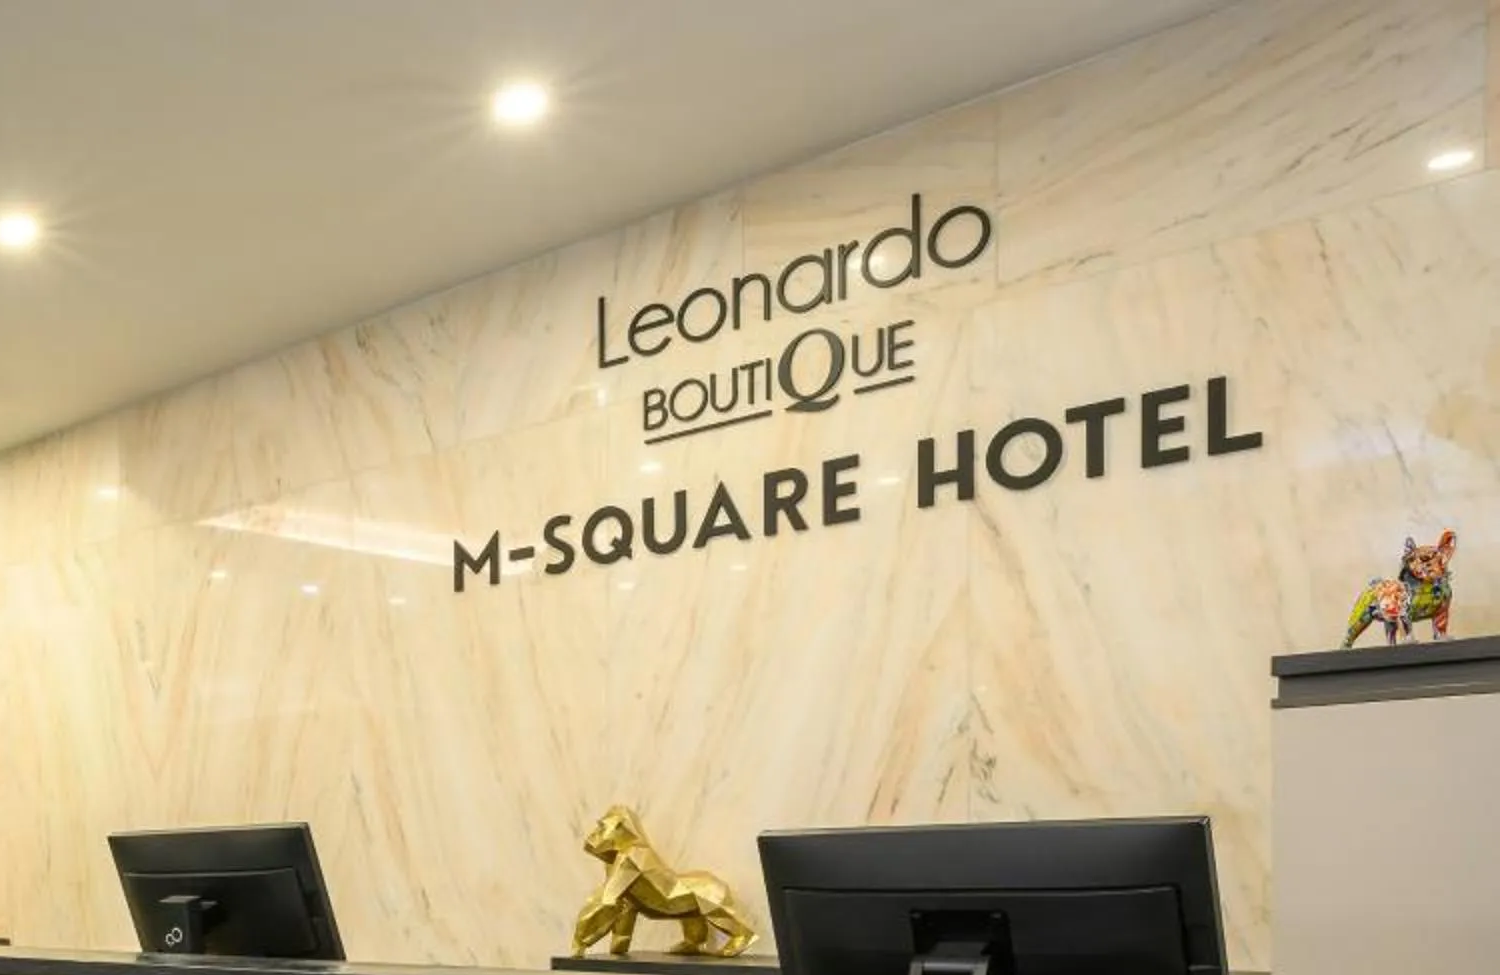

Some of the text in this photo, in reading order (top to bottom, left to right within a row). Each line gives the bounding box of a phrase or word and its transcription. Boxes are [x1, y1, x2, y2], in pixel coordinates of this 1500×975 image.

[598, 193, 992, 369] Leonardo
[643, 319, 915, 432] BOUTIQUE
[453, 376, 1263, 593] M-SQUARE HOTEL
